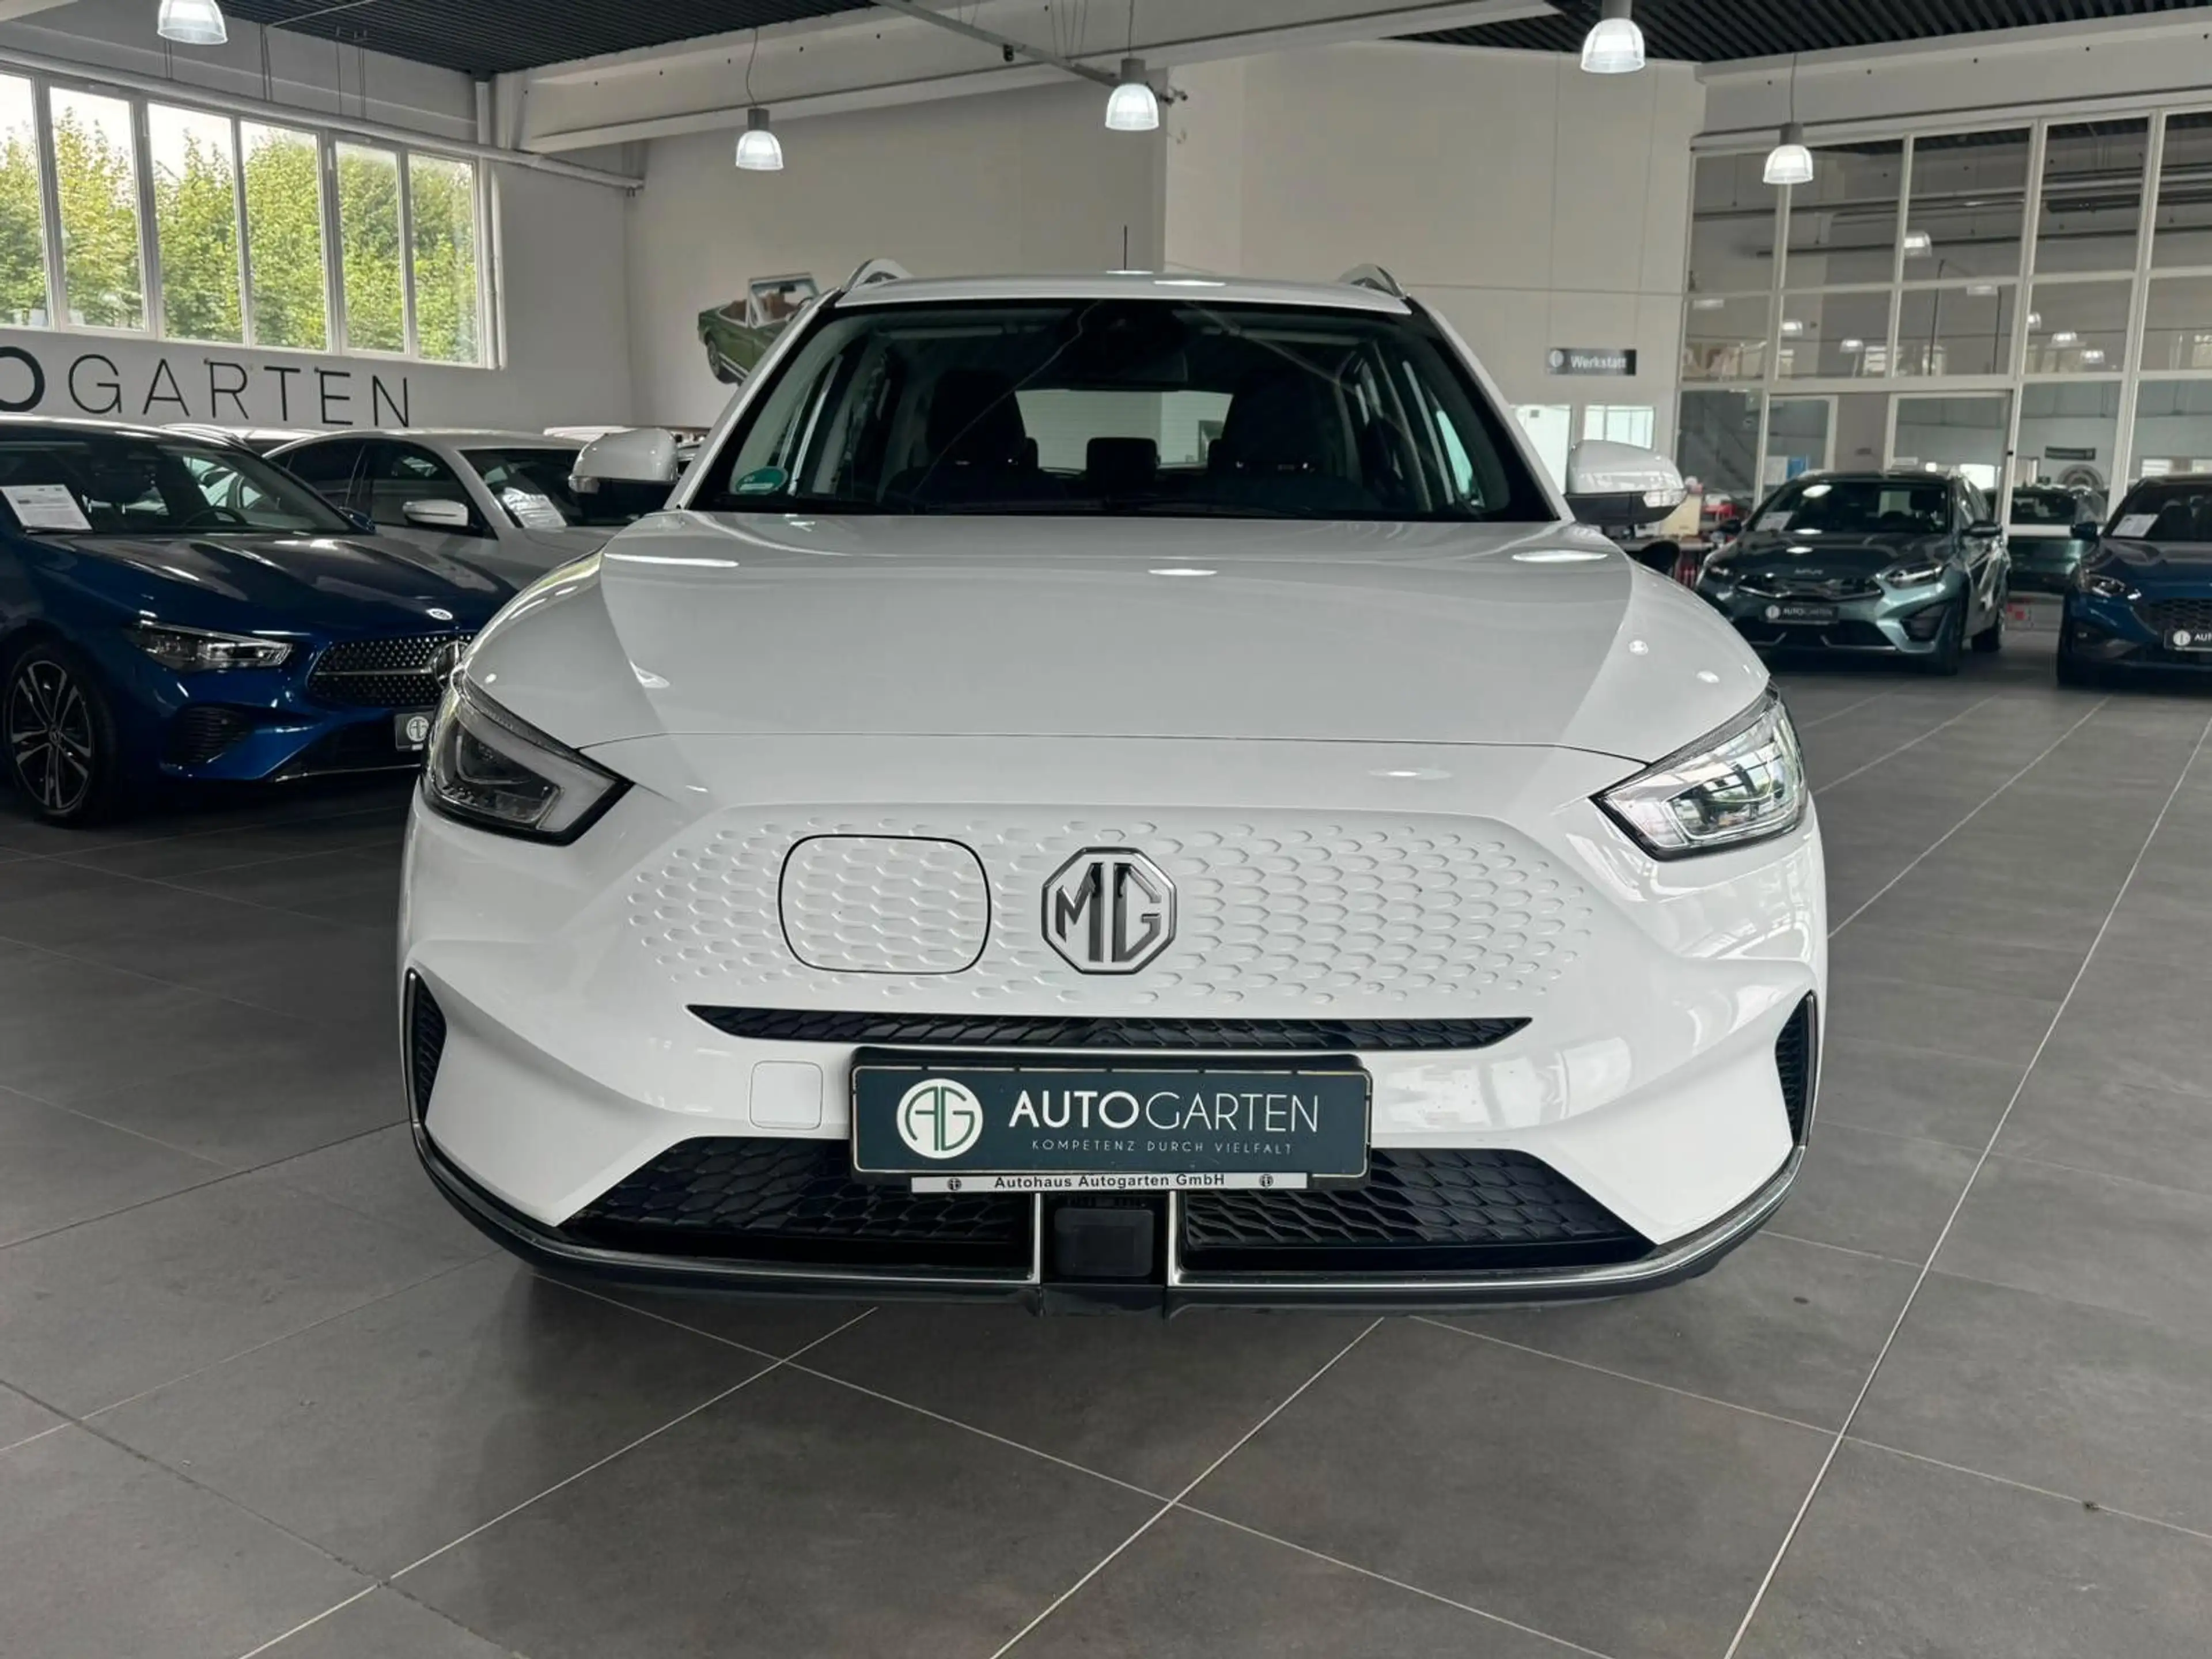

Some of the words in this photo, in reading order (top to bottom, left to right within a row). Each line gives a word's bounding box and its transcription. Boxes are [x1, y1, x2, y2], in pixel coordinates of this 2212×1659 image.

[1570, 355, 1627, 369] Werkstatt
[1055, 862, 1162, 963] MG
[1008, 1090, 1319, 1133] AUTOGARTEN
[1032, 1139, 1135, 1152] KOMPETENZ
[1147, 1141, 1203, 1153] DURCH
[1214, 1142, 1292, 1155] VIELFALT
[994, 1176, 1072, 1189] Autohaus
[1078, 1174, 1169, 1190] Autogarten
[1176, 1173, 1225, 1187] GmbH
